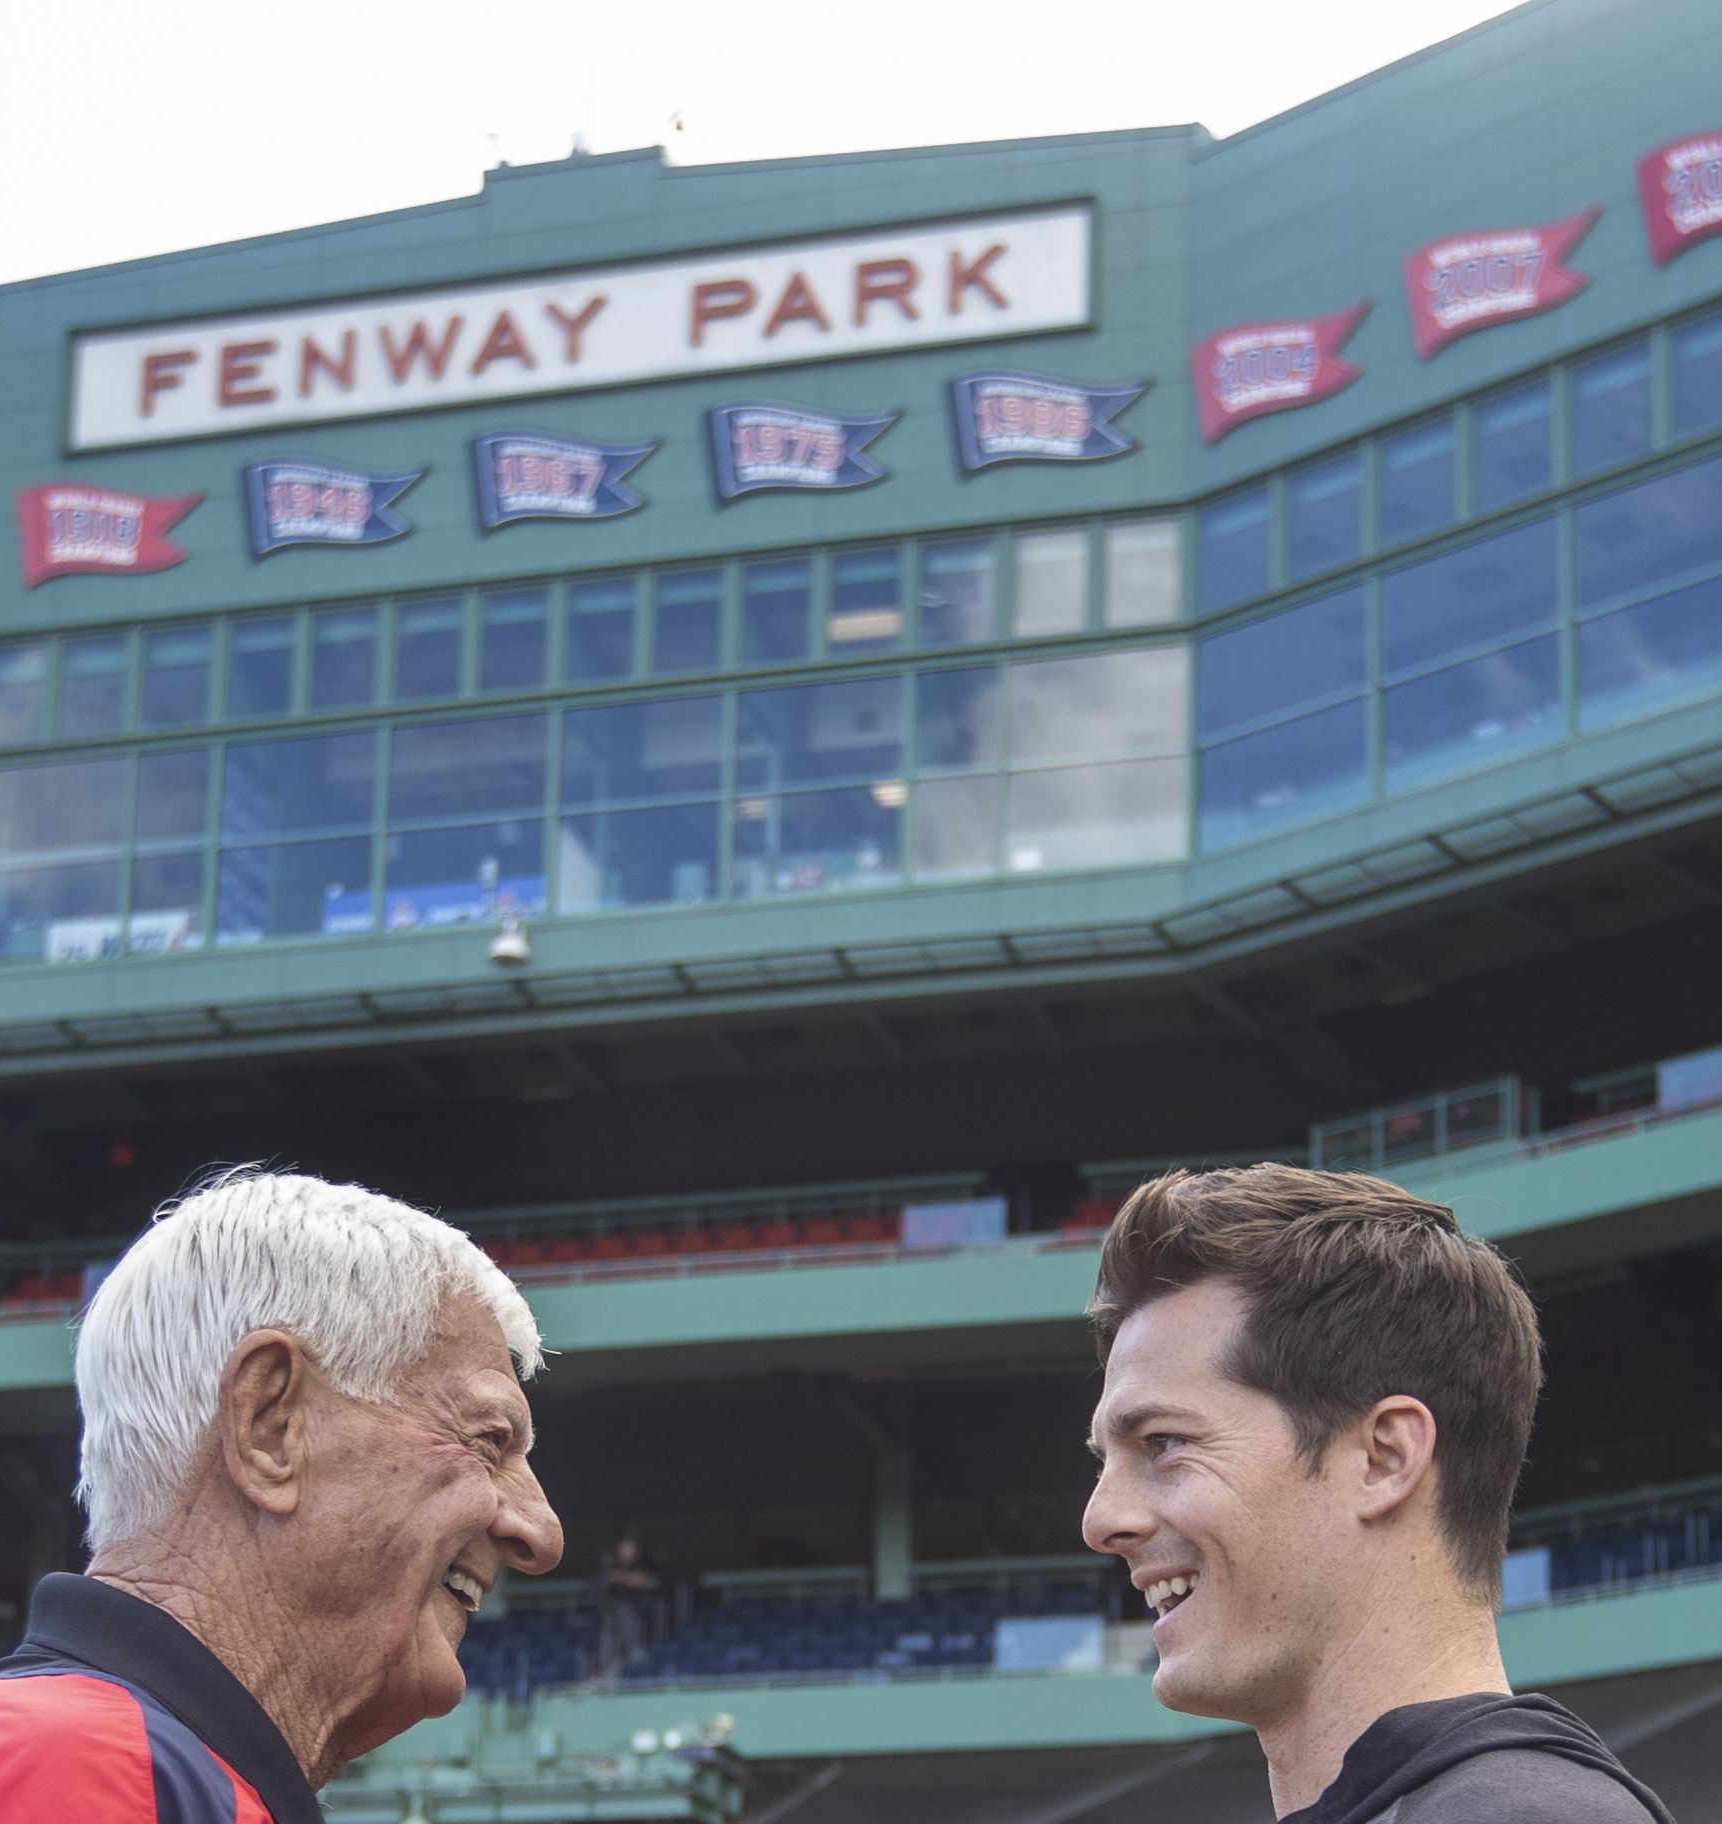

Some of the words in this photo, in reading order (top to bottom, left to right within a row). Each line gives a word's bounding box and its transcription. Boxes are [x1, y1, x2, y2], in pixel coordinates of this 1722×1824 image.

[1423, 251, 1547, 314] 2007
[137, 294, 608, 418] FENWAY
[687, 241, 1012, 349] PARK
[1213, 343, 1319, 399] 2004
[733, 424, 846, 469] 1975
[494, 456, 606, 497] 1967
